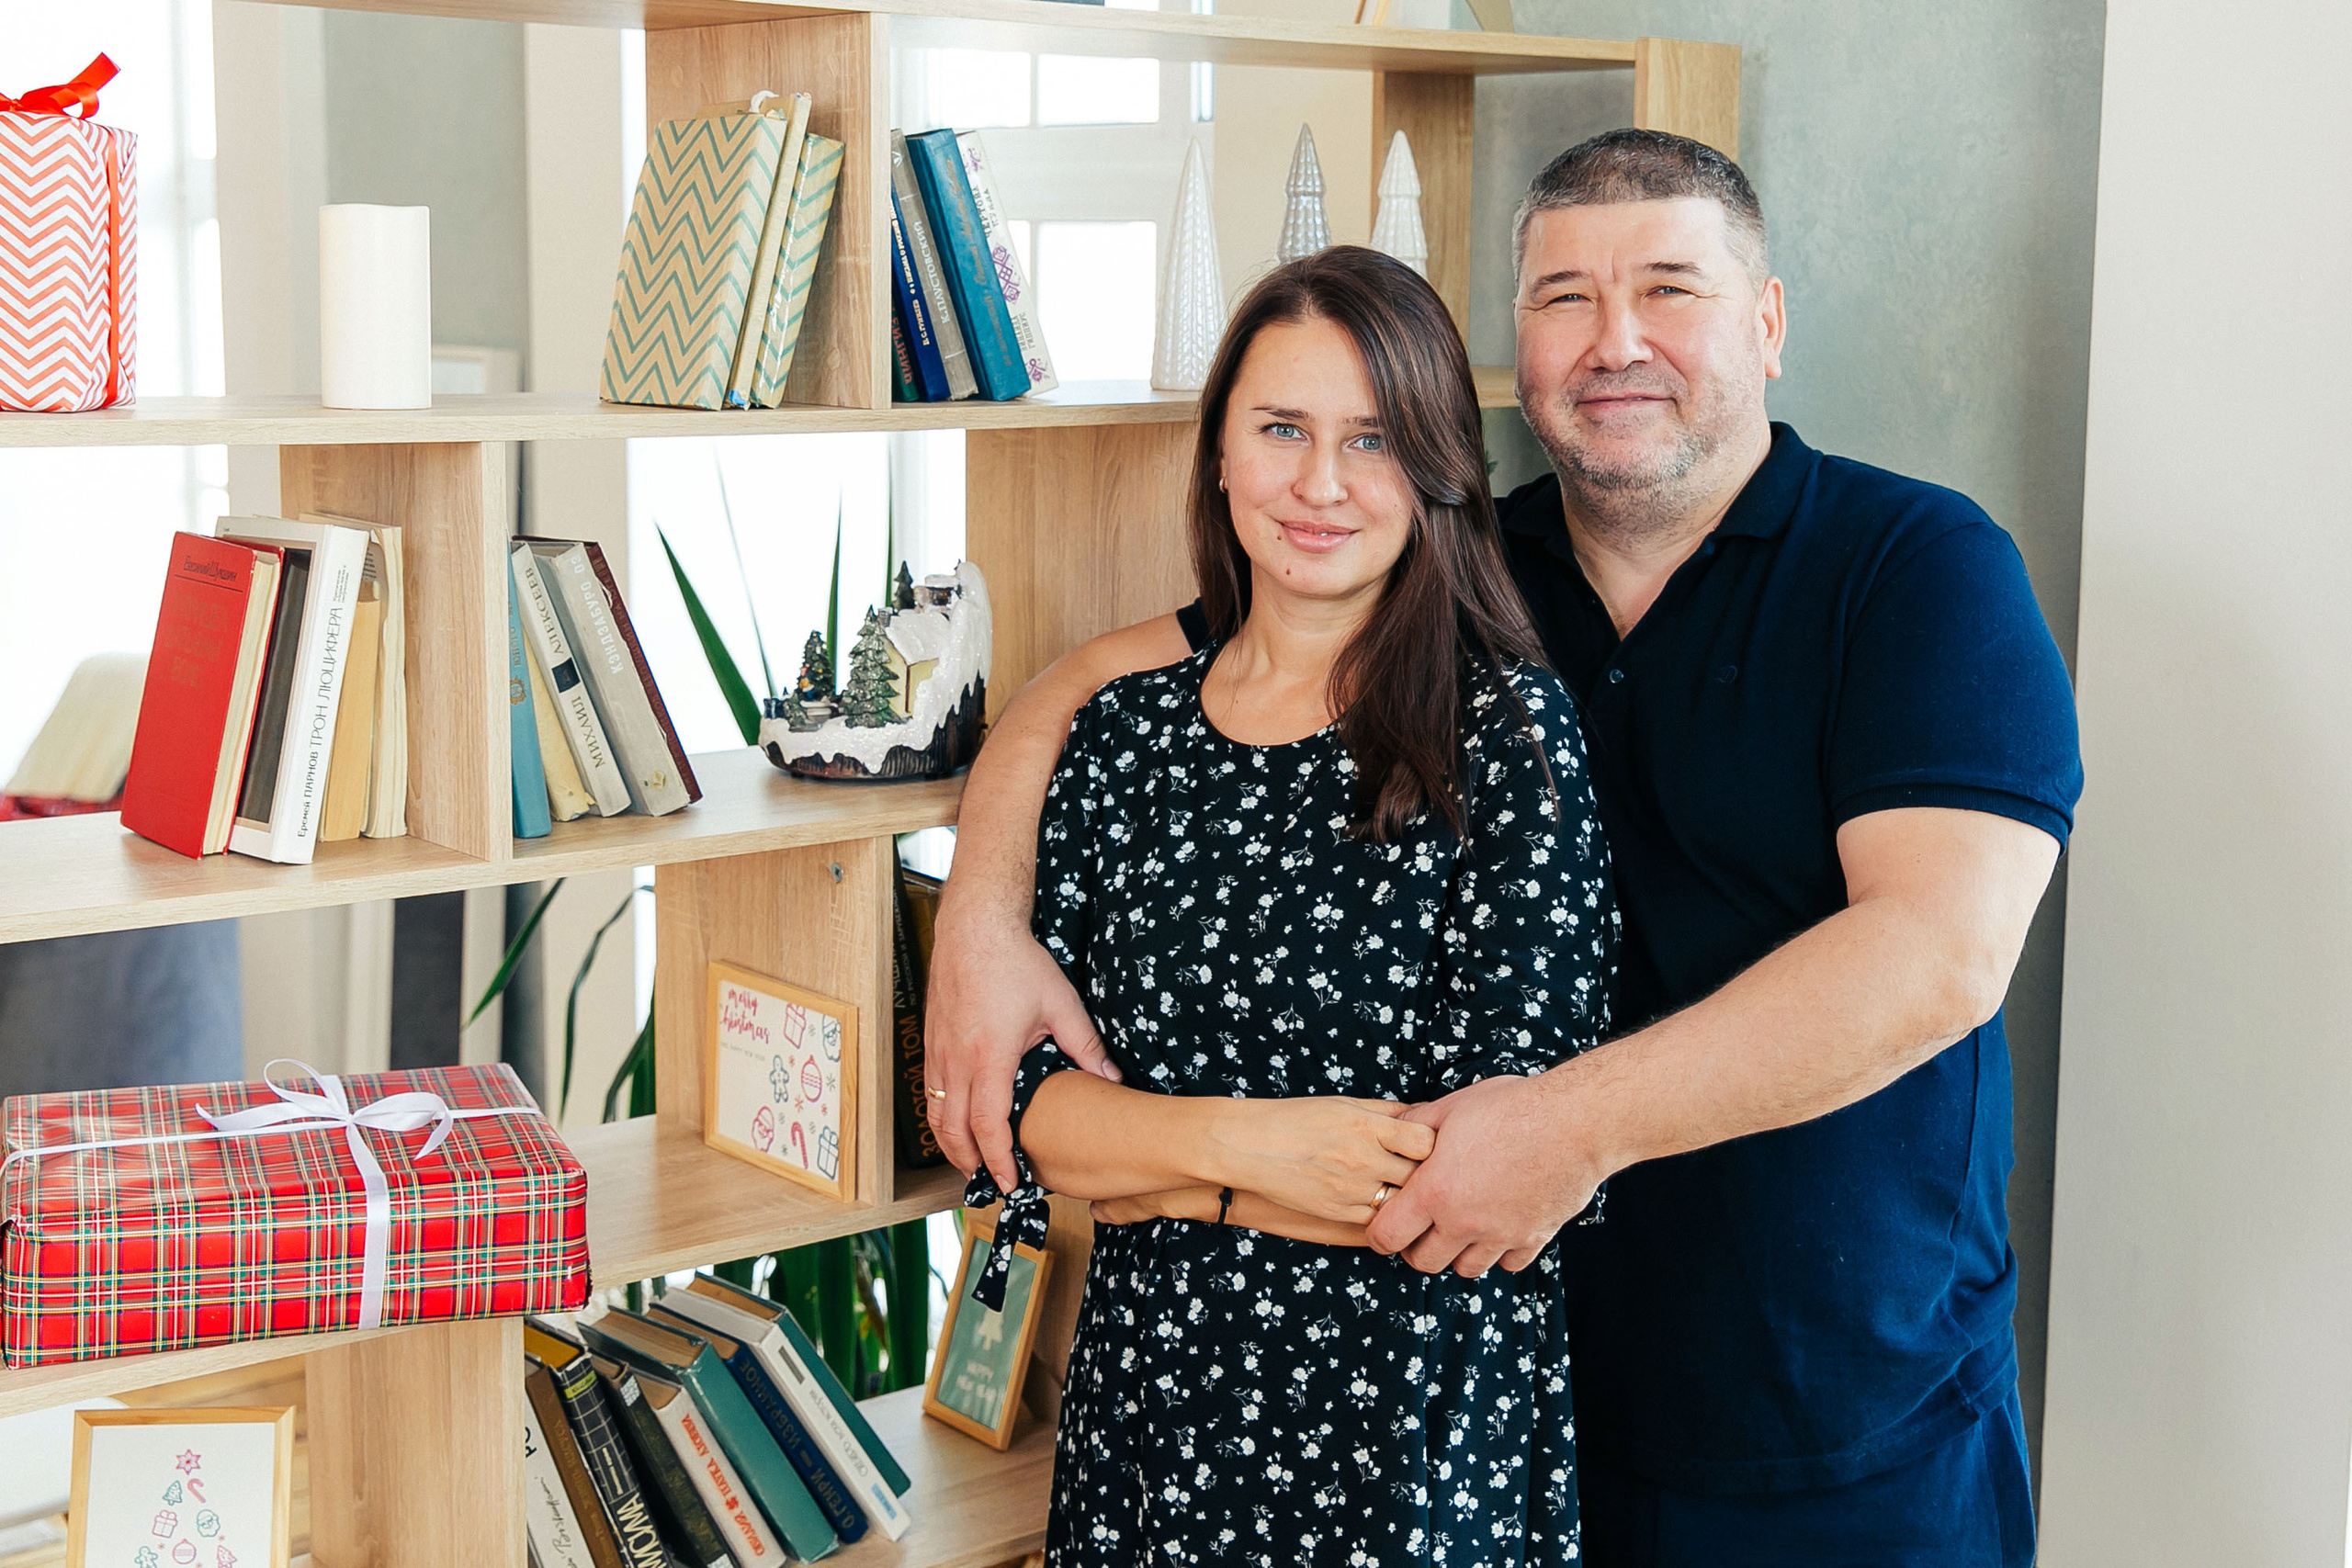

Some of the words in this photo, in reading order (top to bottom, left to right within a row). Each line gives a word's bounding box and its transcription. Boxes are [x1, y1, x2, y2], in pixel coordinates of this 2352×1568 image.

[972, 186, 993, 238] ЧЕРТОВА
[1012, 315, 1026, 351] ЗИНАИДА
[1017, 311, 1035, 349] ГИППИУС
[525, 567, 564, 655] АЛЕКСЕЕВ
[581, 581, 623, 673] КЭНДЗАБУРО
[317, 606, 344, 700] ЛЮЦИФЕРА
[310, 704, 328, 749] ТРОН
[571, 695, 605, 768] МИХАИЛ
[303, 750, 319, 797] ПАРНОВ
[297, 800, 312, 838] Еремей
[900, 952, 916, 991] РУССКОЙ
[719, 1003, 770, 1043] hristmas
[899, 1014, 924, 1059] ТОМ
[904, 1063, 942, 1156] ЗОЛОТОЙ
[739, 1359, 801, 1450] ИЗБРАННОЕ
